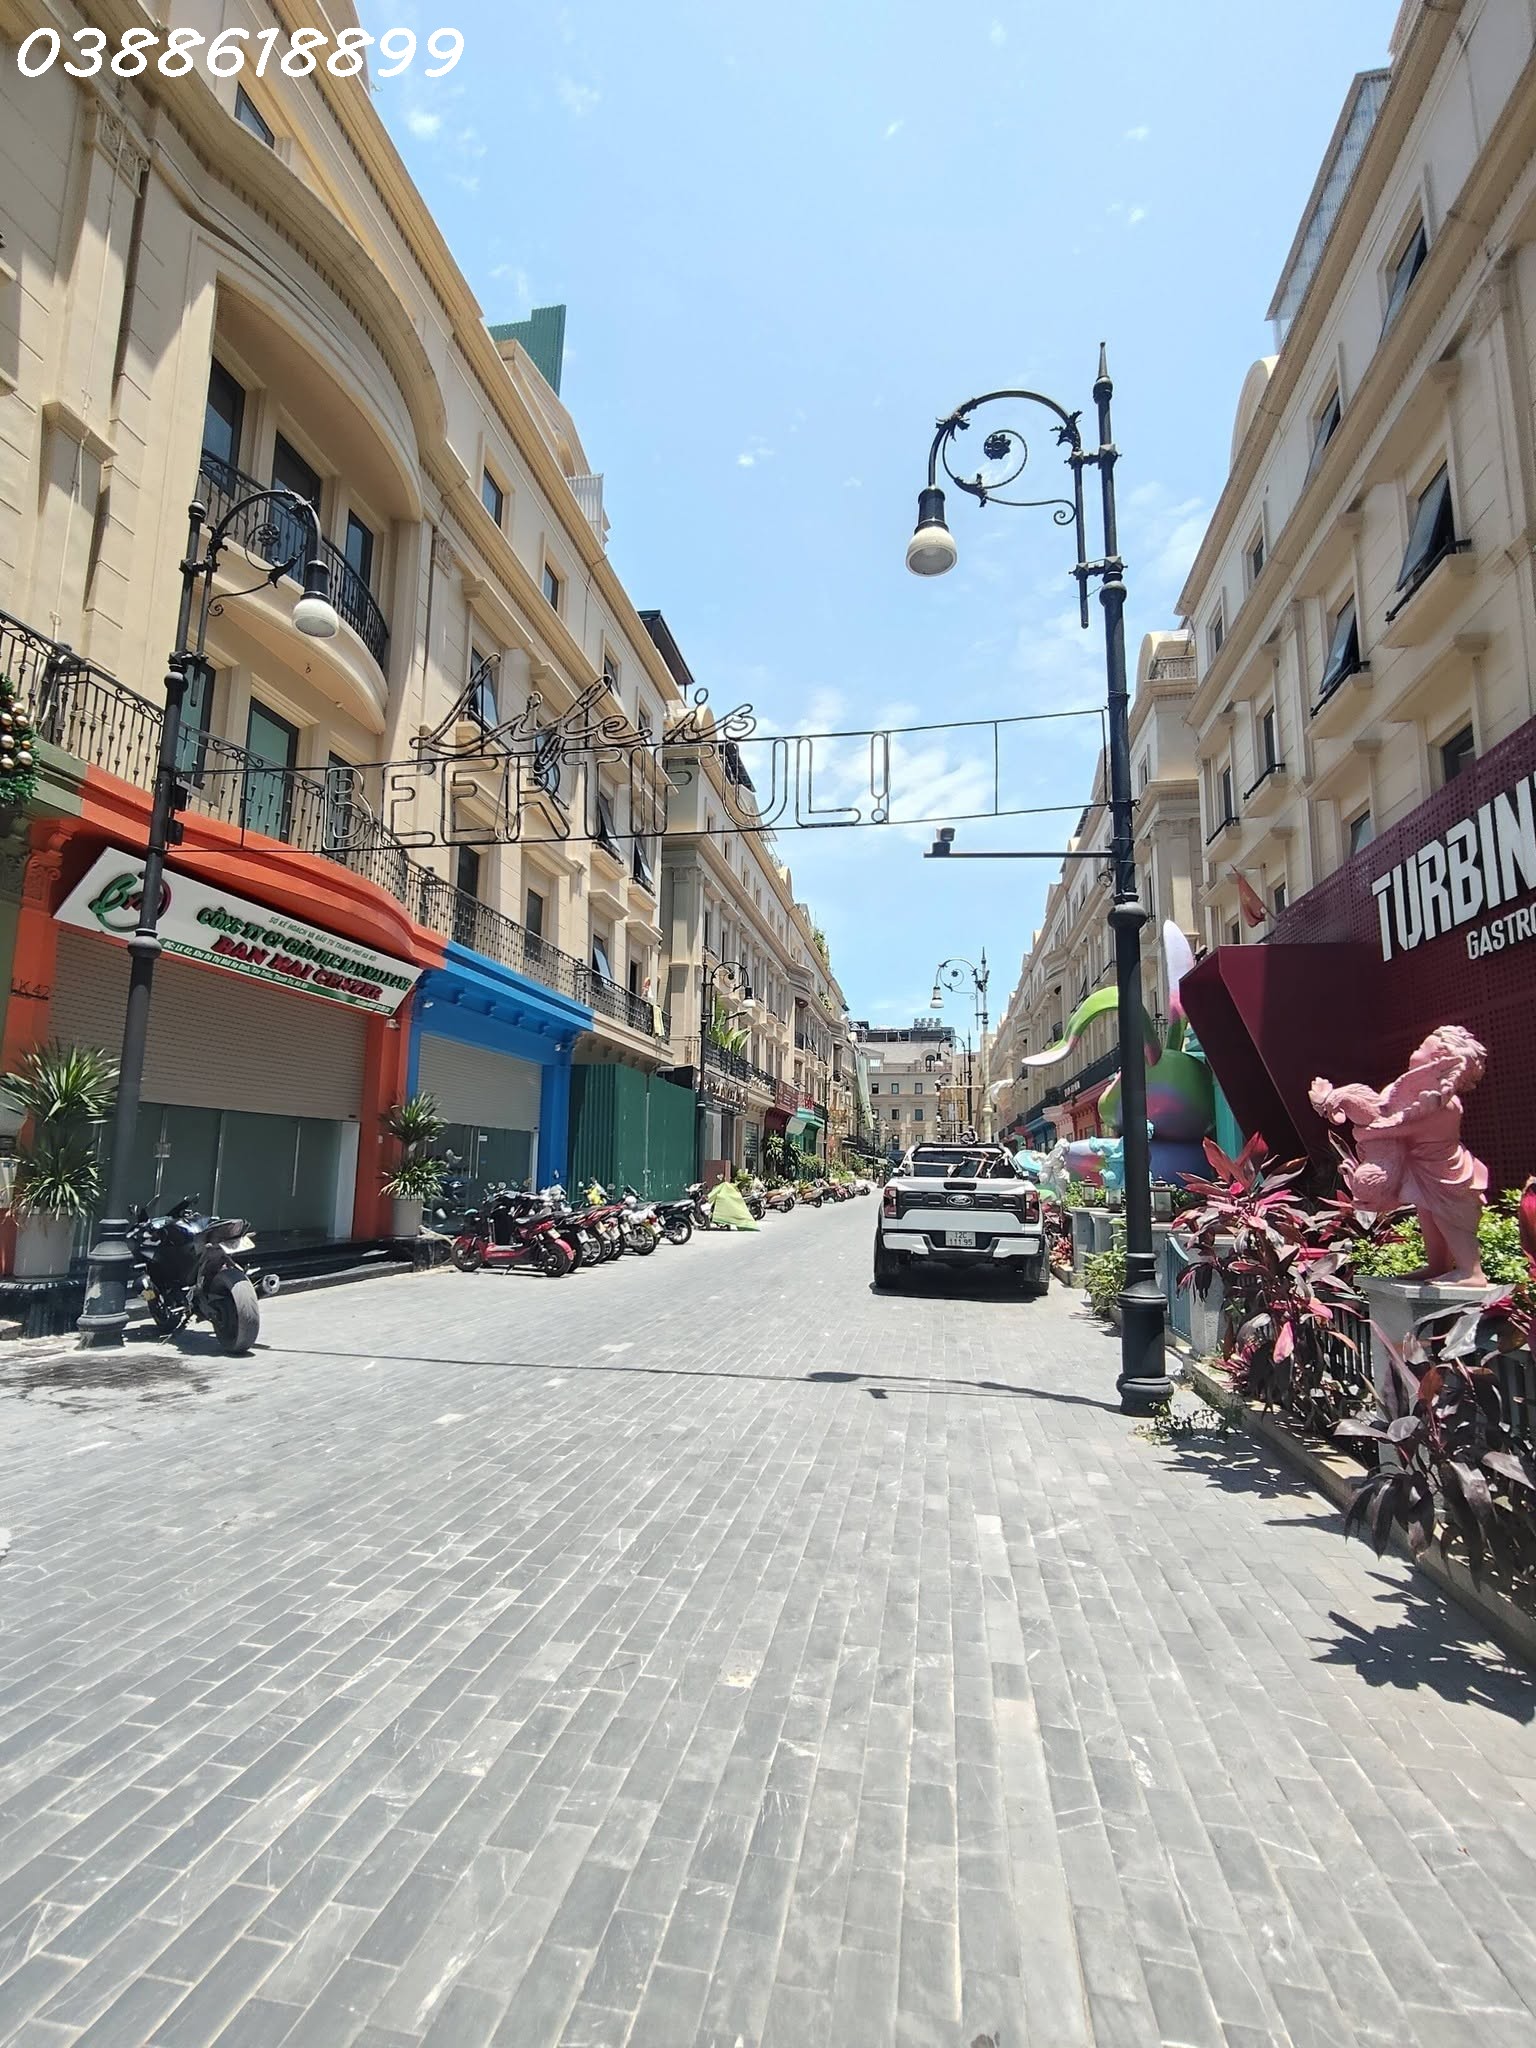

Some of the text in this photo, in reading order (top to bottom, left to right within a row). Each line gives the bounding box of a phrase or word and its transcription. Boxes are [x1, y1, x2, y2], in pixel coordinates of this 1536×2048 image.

[409, 652, 757, 775] Life is
[322, 733, 888, 851] BEERTIFUL!
[1372, 771, 1536, 963] TURBIN
[211, 935, 383, 1001] BAN MAI CENTER
